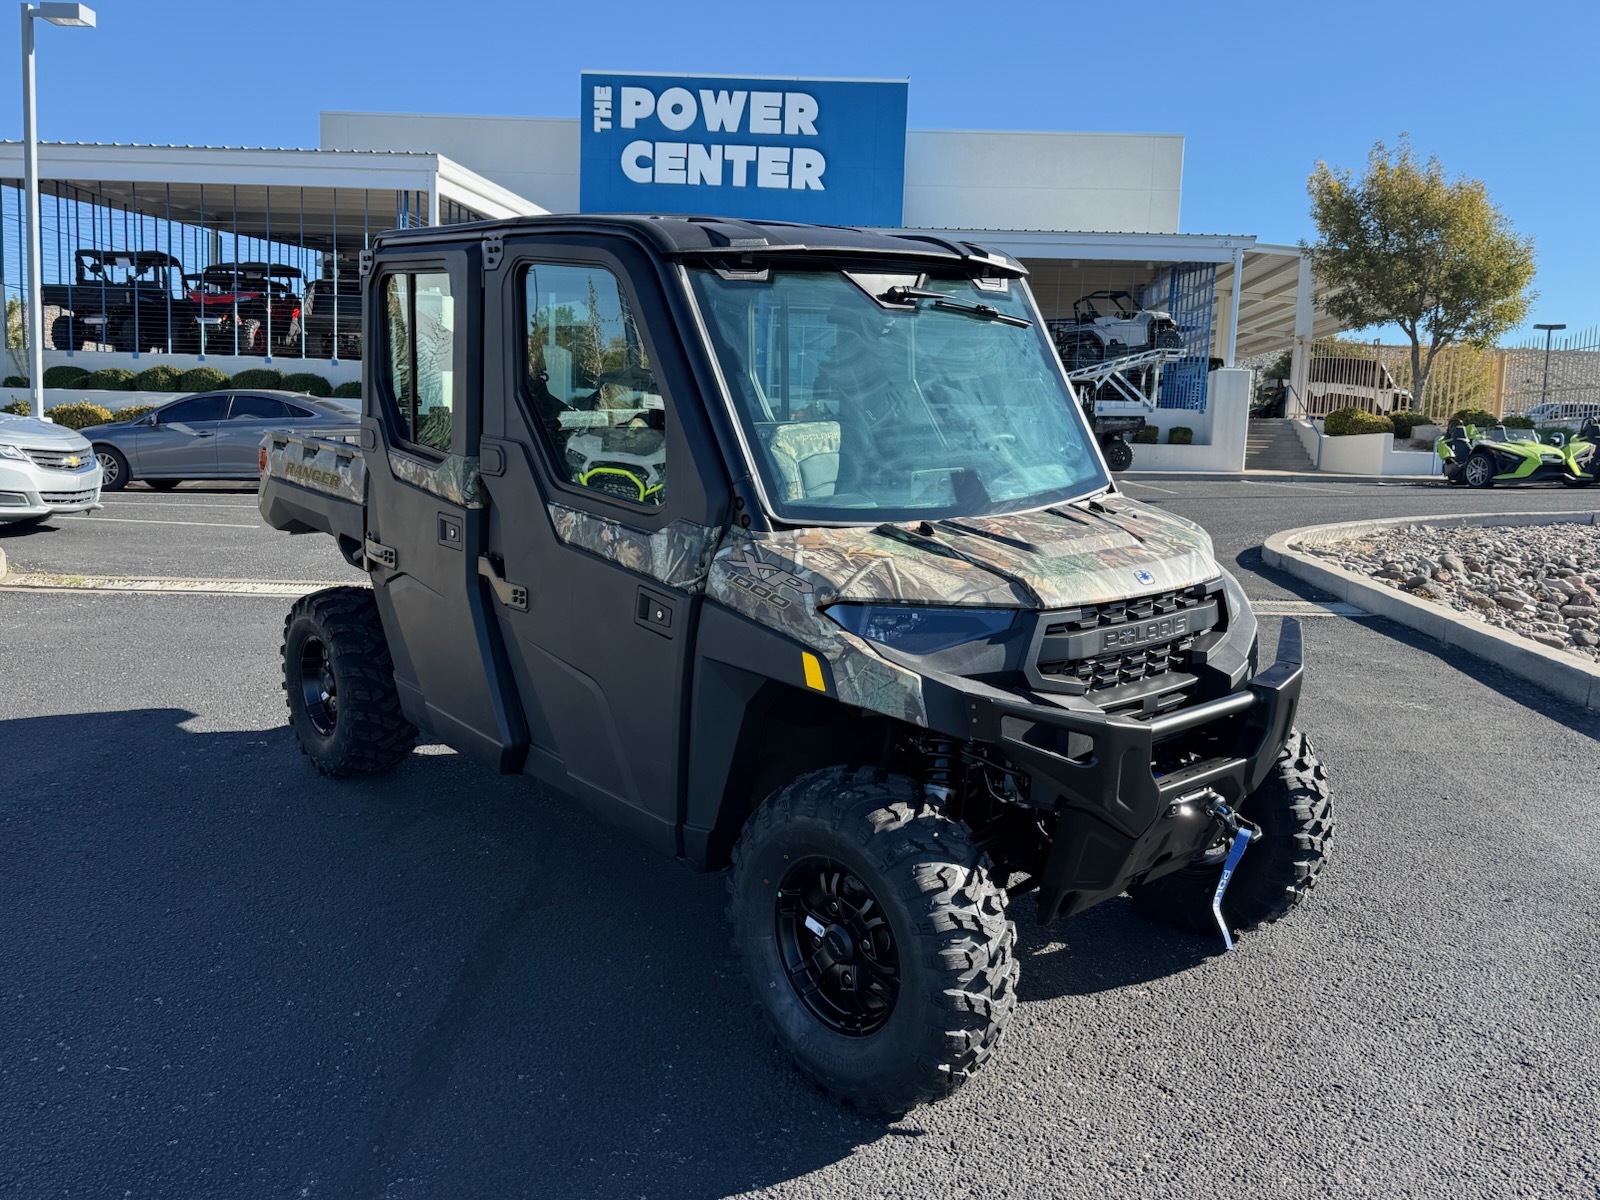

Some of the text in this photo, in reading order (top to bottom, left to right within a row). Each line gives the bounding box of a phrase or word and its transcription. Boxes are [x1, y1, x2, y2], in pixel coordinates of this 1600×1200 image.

[593, 86, 612, 133] THE
[620, 86, 819, 135] POWER
[620, 139, 826, 191] CENTER
[286, 463, 341, 487] RANGER
[720, 549, 815, 594] XP
[726, 571, 792, 610] 1000
[1104, 615, 1186, 649] POLARIS
